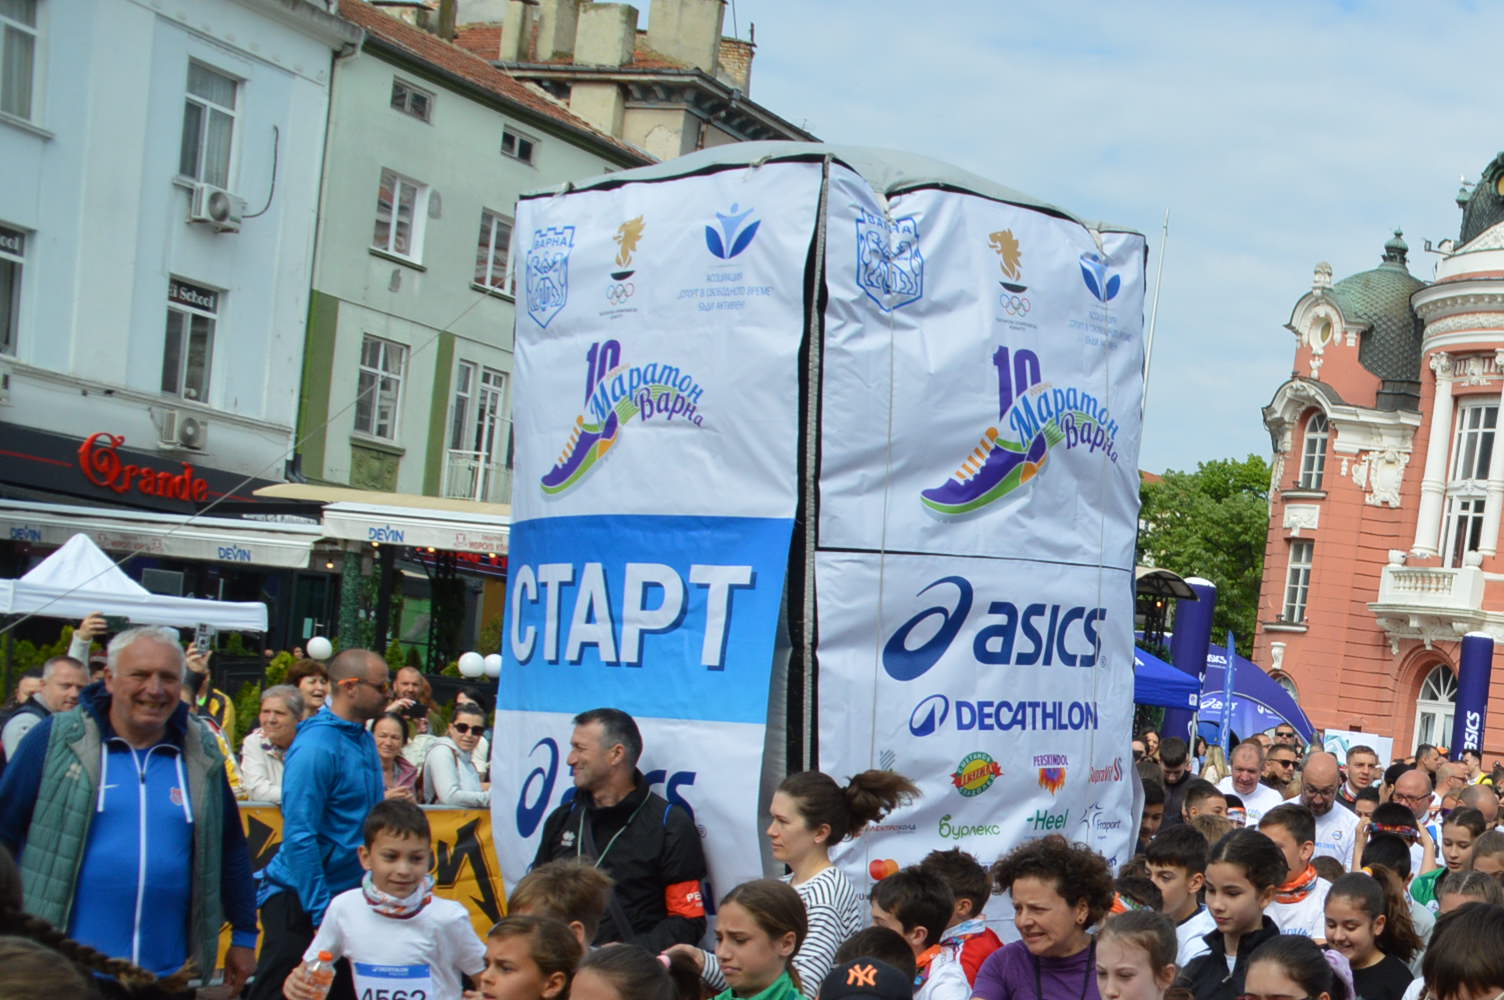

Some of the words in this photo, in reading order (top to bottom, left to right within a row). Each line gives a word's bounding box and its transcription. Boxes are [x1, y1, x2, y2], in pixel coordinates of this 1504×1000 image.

[590, 362, 704, 426] Маратон
[634, 387, 704, 427] Варна
[1010, 387, 1119, 449] Маратон
[1061, 413, 1119, 464] Варна
[77, 432, 208, 501] Grande
[218, 545, 251, 561] DEVIN
[368, 525, 405, 543] DEVIN
[510, 562, 756, 670] СТАРТ
[956, 699, 1099, 731] DECATHLON
[1033, 754, 1069, 767] PERSKINDOL
[1097, 820, 1121, 832] Fraport
